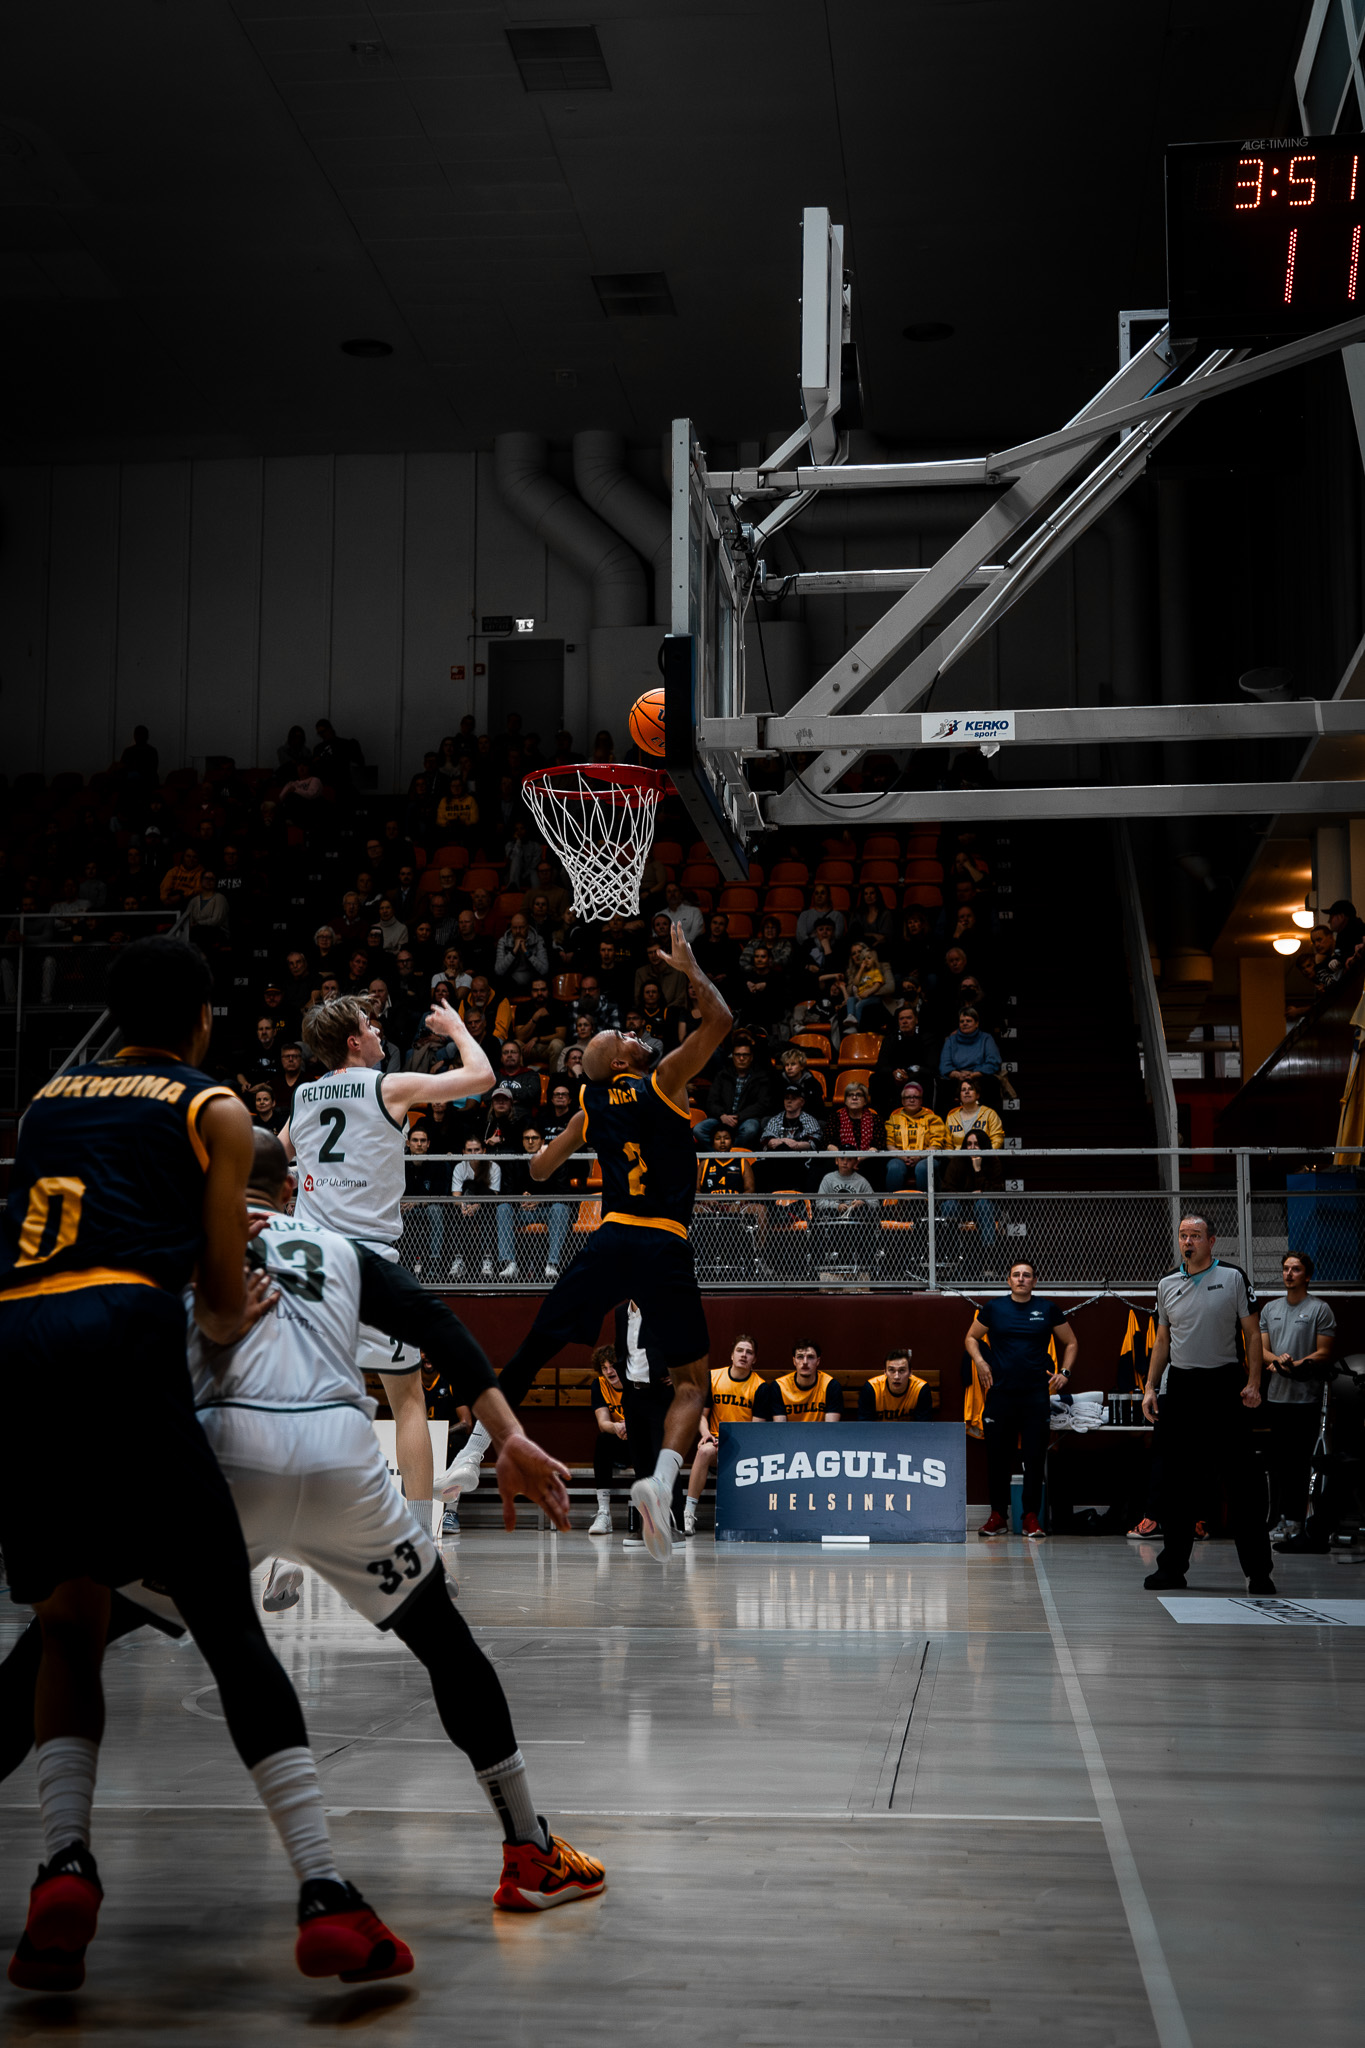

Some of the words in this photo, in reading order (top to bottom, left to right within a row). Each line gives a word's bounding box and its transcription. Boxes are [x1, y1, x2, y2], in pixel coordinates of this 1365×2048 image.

[965, 720, 1009, 731] KERKO
[974, 730, 997, 738] sport
[1006, 1062, 1013, 1072] 6
[302, 1083, 365, 1103] PELTONIEMI
[1008, 1099, 1015, 1110] 5
[318, 1107, 346, 1164] 2
[1009, 1138, 1016, 1147] 4
[622, 1141, 648, 1196] 2
[316, 1179, 329, 1188] OP
[329, 1178, 367, 1188] Uusimaa
[1010, 1180, 1018, 1190] 3
[389, 1336, 405, 1363] 2
[713, 1394, 752, 1409] GULLS
[785, 1402, 826, 1415] GULLS
[735, 1450, 947, 1488] SEAGULLS
[768, 1493, 912, 1512] HELSINKI
[366, 1540, 422, 1595] 33
